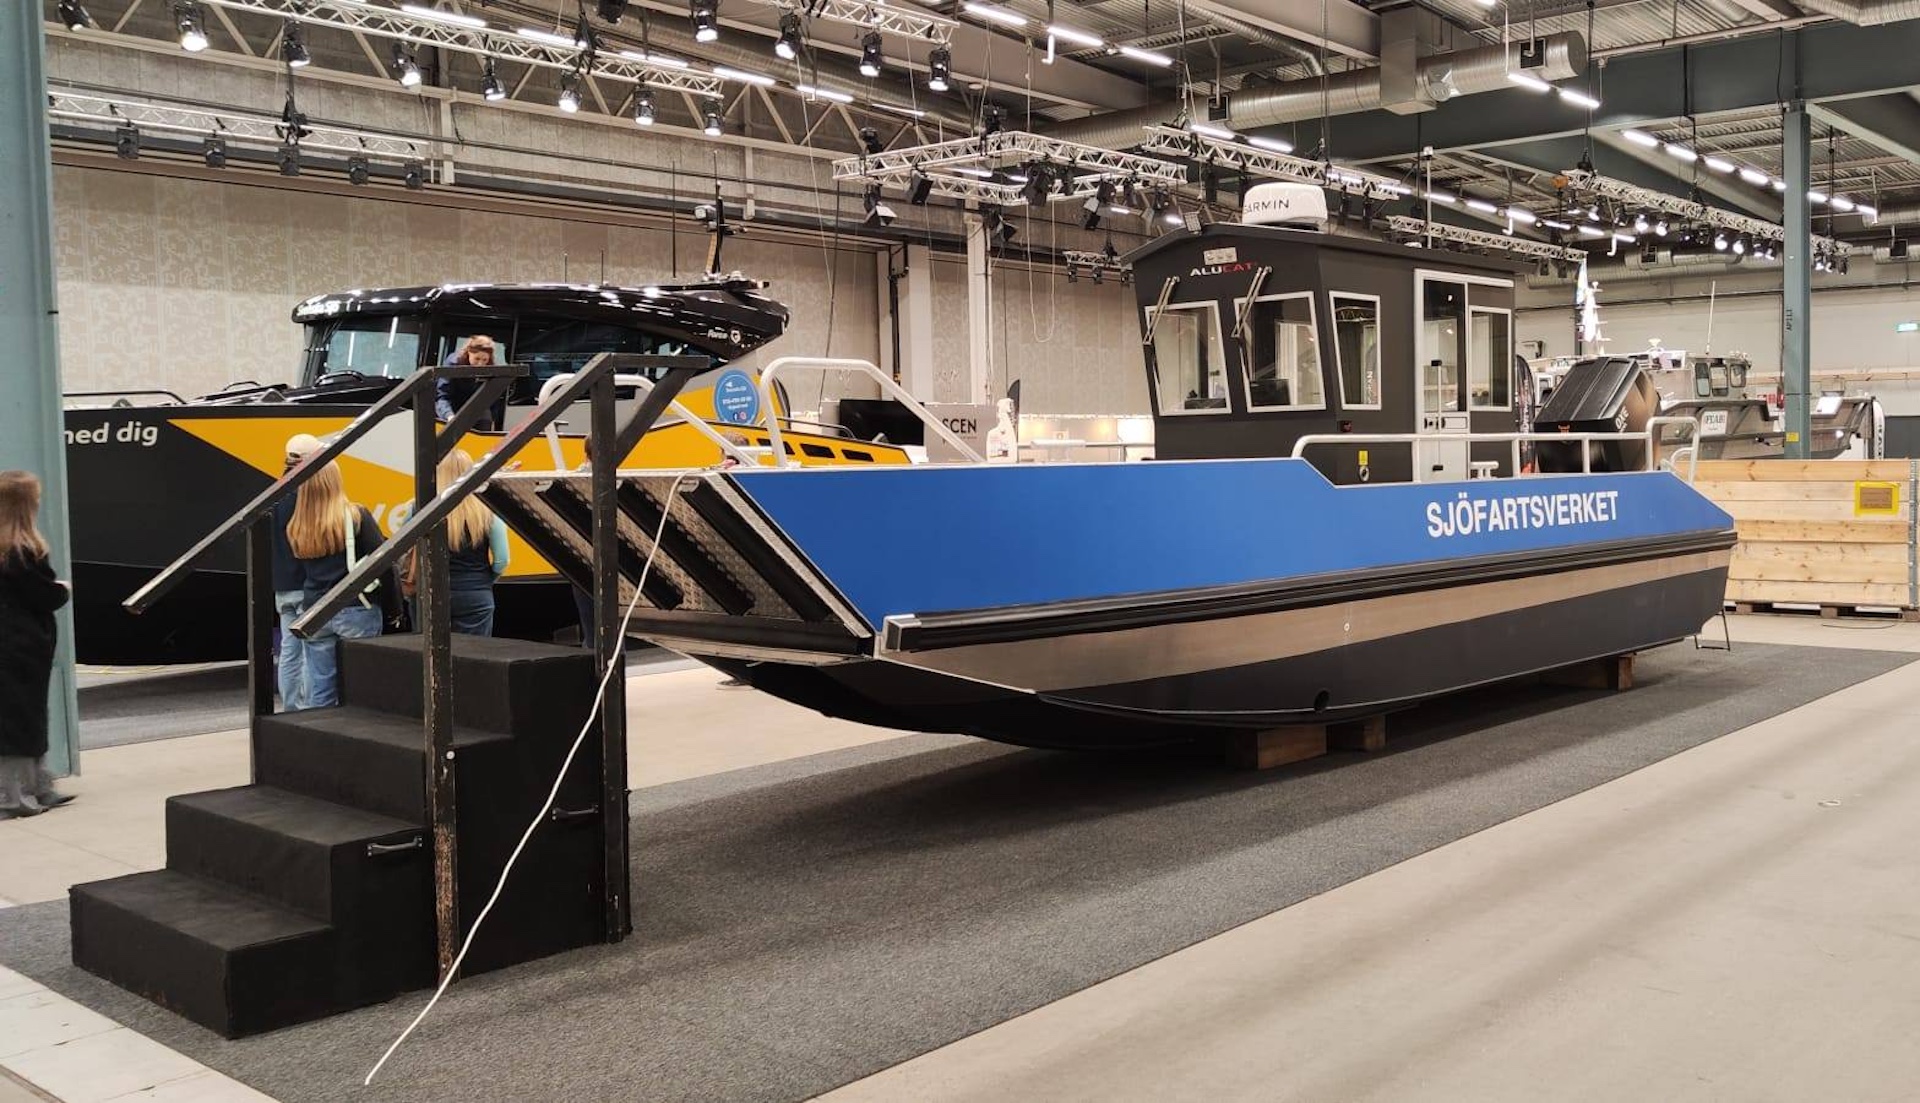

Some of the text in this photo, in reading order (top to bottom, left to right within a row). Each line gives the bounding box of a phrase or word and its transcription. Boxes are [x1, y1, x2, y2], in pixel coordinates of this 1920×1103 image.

[1244, 199, 1290, 214] GARMIN
[1190, 262, 1253, 277] ALUCAT
[116, 420, 158, 447] dig
[1426, 490, 1619, 538] SJÖFARTSVERKET
